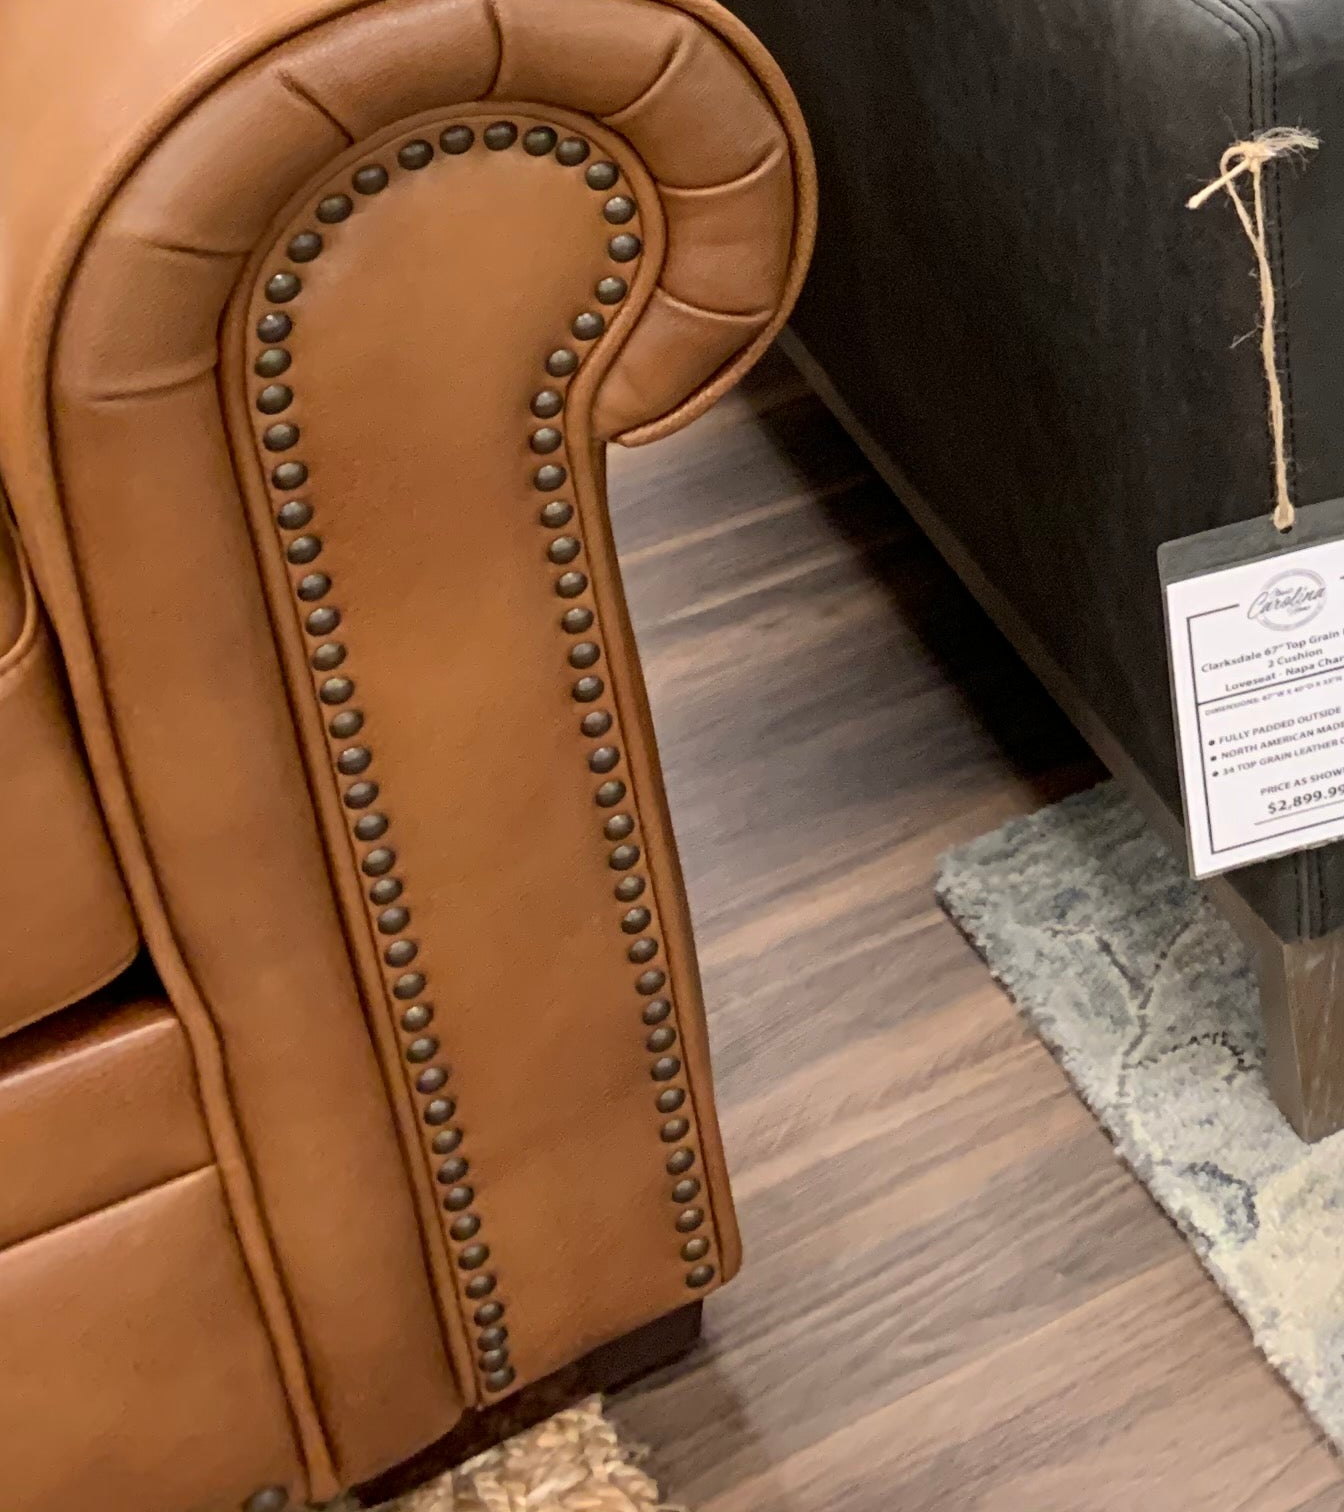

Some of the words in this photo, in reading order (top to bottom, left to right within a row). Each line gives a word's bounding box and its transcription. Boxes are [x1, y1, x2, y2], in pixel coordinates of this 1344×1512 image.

[1247, 587, 1326, 619] Carolina
[1201, 652, 1262, 672] Clarksdale
[1286, 638, 1307, 650] Top
[1309, 631, 1339, 644] Grain
[1268, 660, 1274, 668] 2
[1277, 648, 1323, 665] Cushion
[1225, 673, 1276, 692] Loveseat
[1285, 662, 1315, 676] Napa
[1219, 730, 1250, 744] FULLY
[1252, 719, 1295, 735] PADDED
[1297, 707, 1342, 724] OUTSIDE
[1221, 744, 1257, 759] NORTH
[1260, 730, 1314, 749] AMERICAN
[1238, 761, 1256, 771] TOP
[1259, 752, 1292, 765] GRAIN
[1294, 737, 1338, 756] LEATHER
[1260, 782, 1291, 795] PRICE
[1294, 778, 1307, 787] AS
